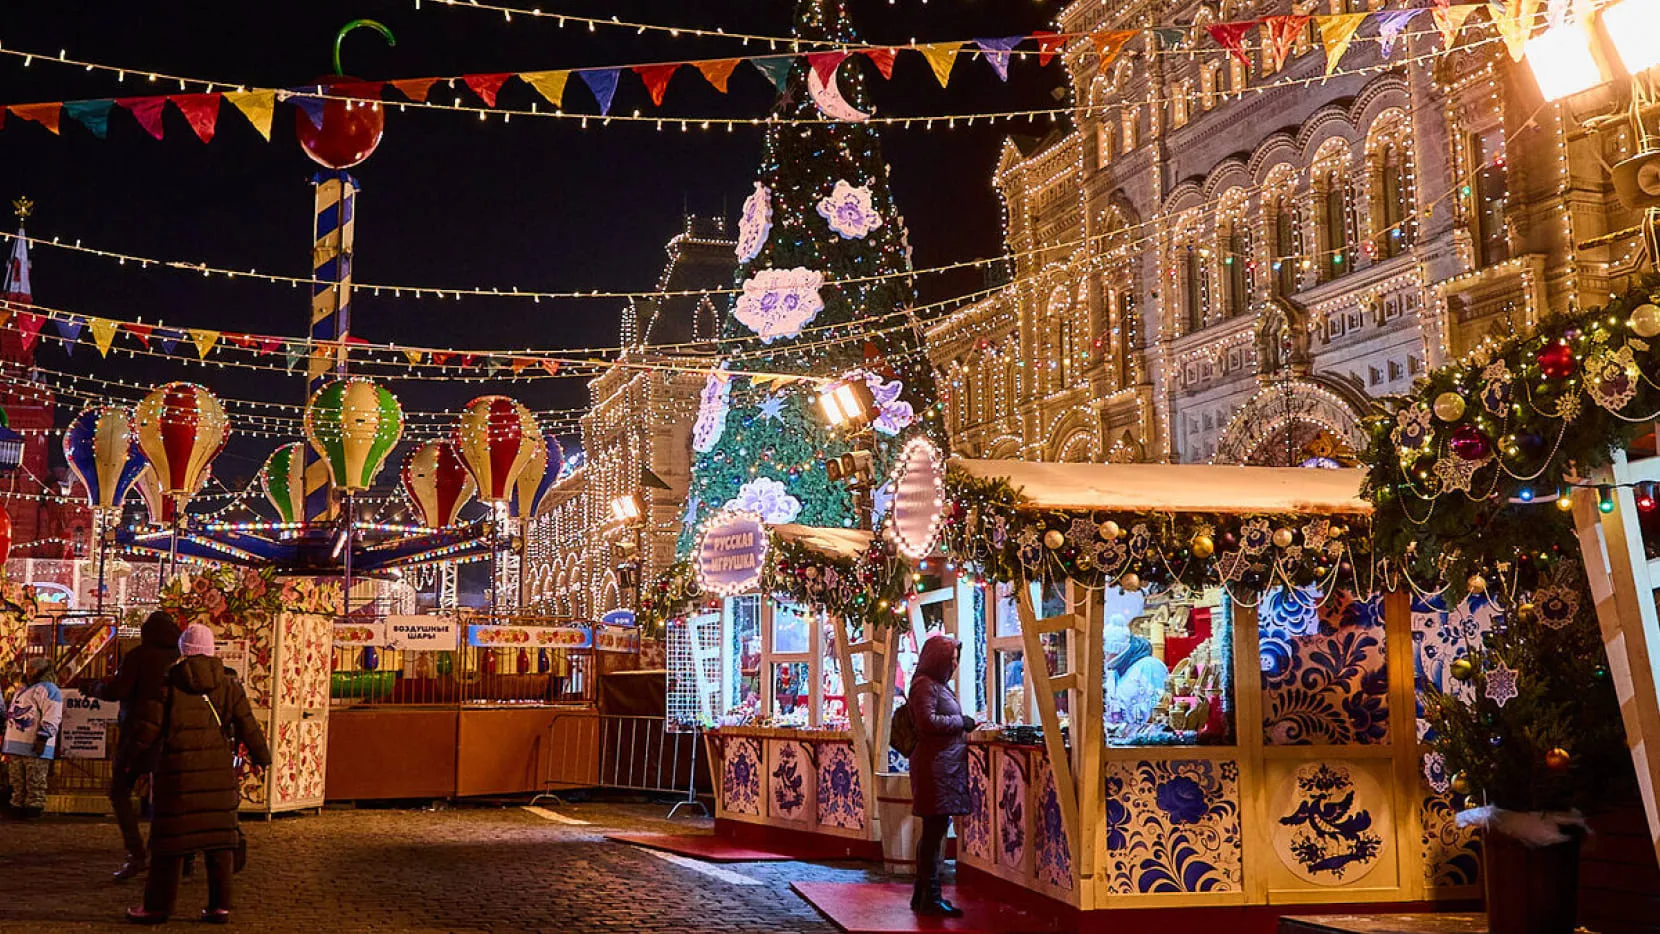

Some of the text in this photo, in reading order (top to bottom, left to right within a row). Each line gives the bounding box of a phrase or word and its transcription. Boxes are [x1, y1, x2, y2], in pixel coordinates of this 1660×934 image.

[713, 532, 754, 552] РУССКАЯ
[711, 552, 756, 572] ИГРУШКА
[393, 625, 449, 633] ВОЗДУШНЫЕ
[67, 698, 100, 710] ВХОД
